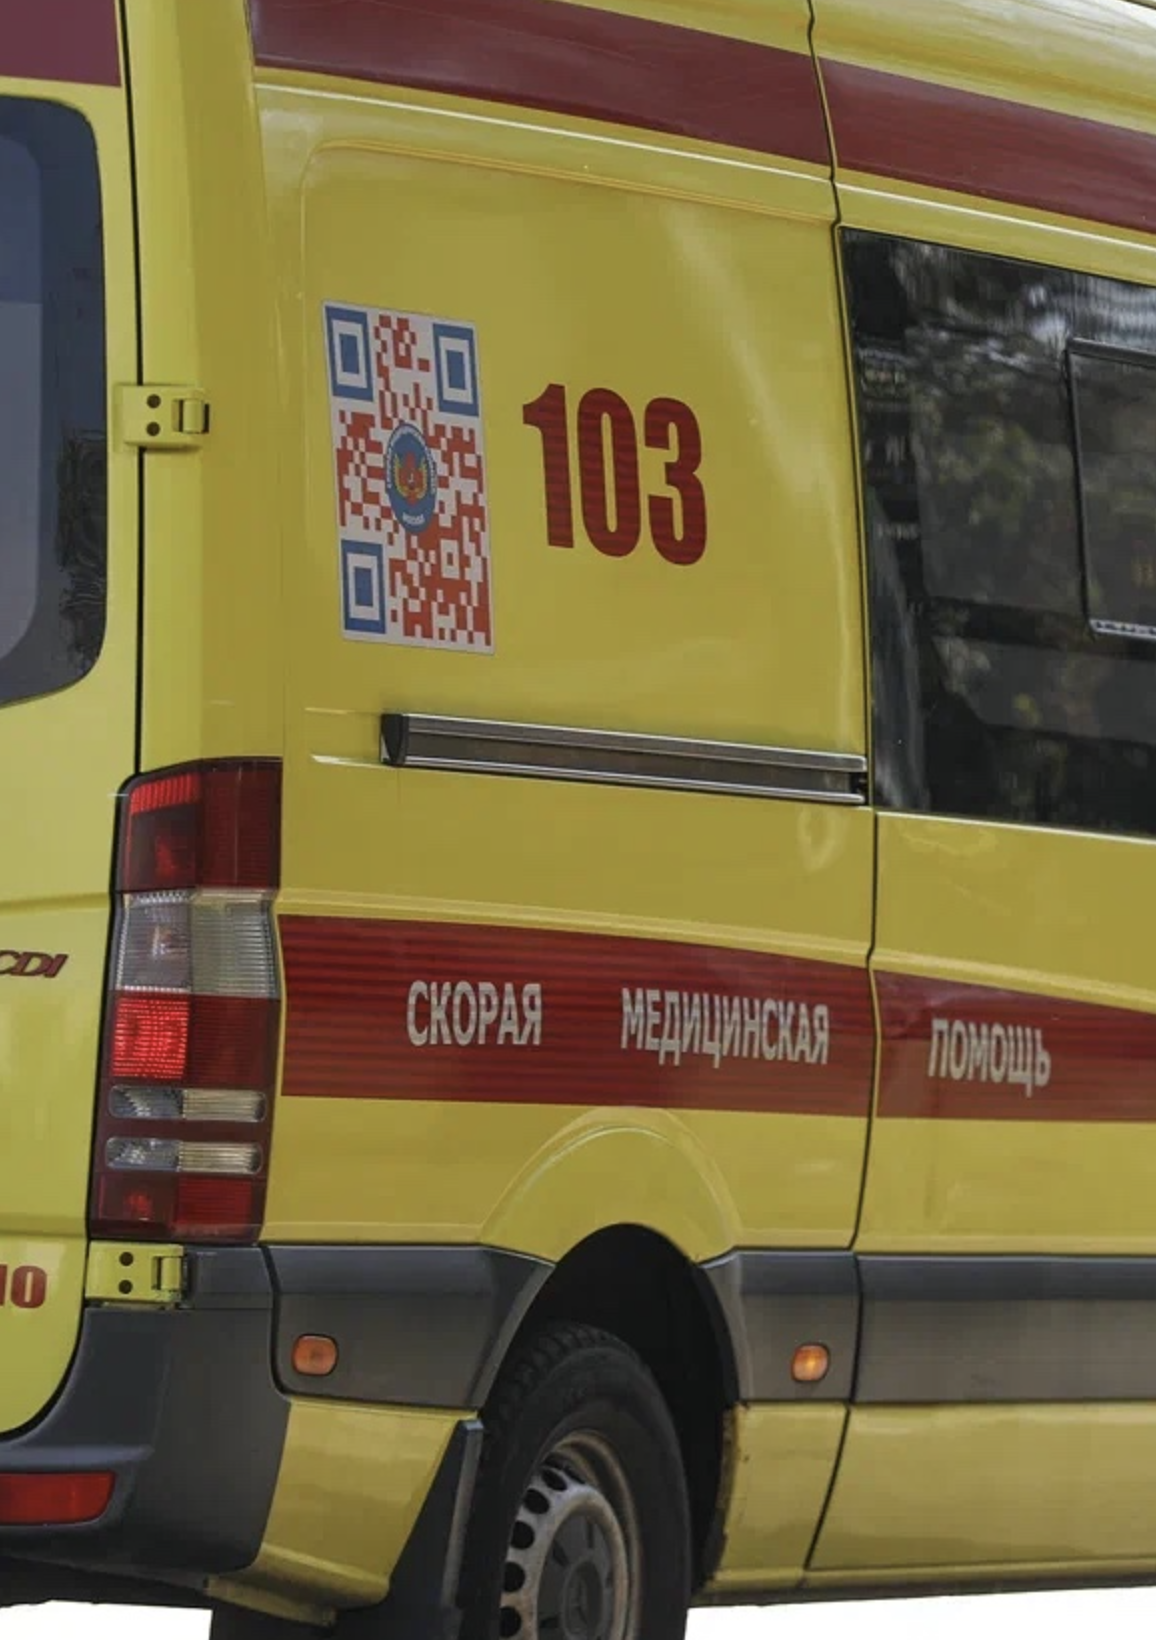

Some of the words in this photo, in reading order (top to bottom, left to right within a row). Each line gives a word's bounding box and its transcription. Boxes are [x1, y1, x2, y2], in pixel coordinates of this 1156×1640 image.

[522, 382, 708, 567] 103
[406, 980, 542, 1046] СКОРАЯ
[620, 987, 830, 1069] МЕДИЦИНСКАЯ
[927, 1017, 1051, 1098] ПОМОЩЬ
